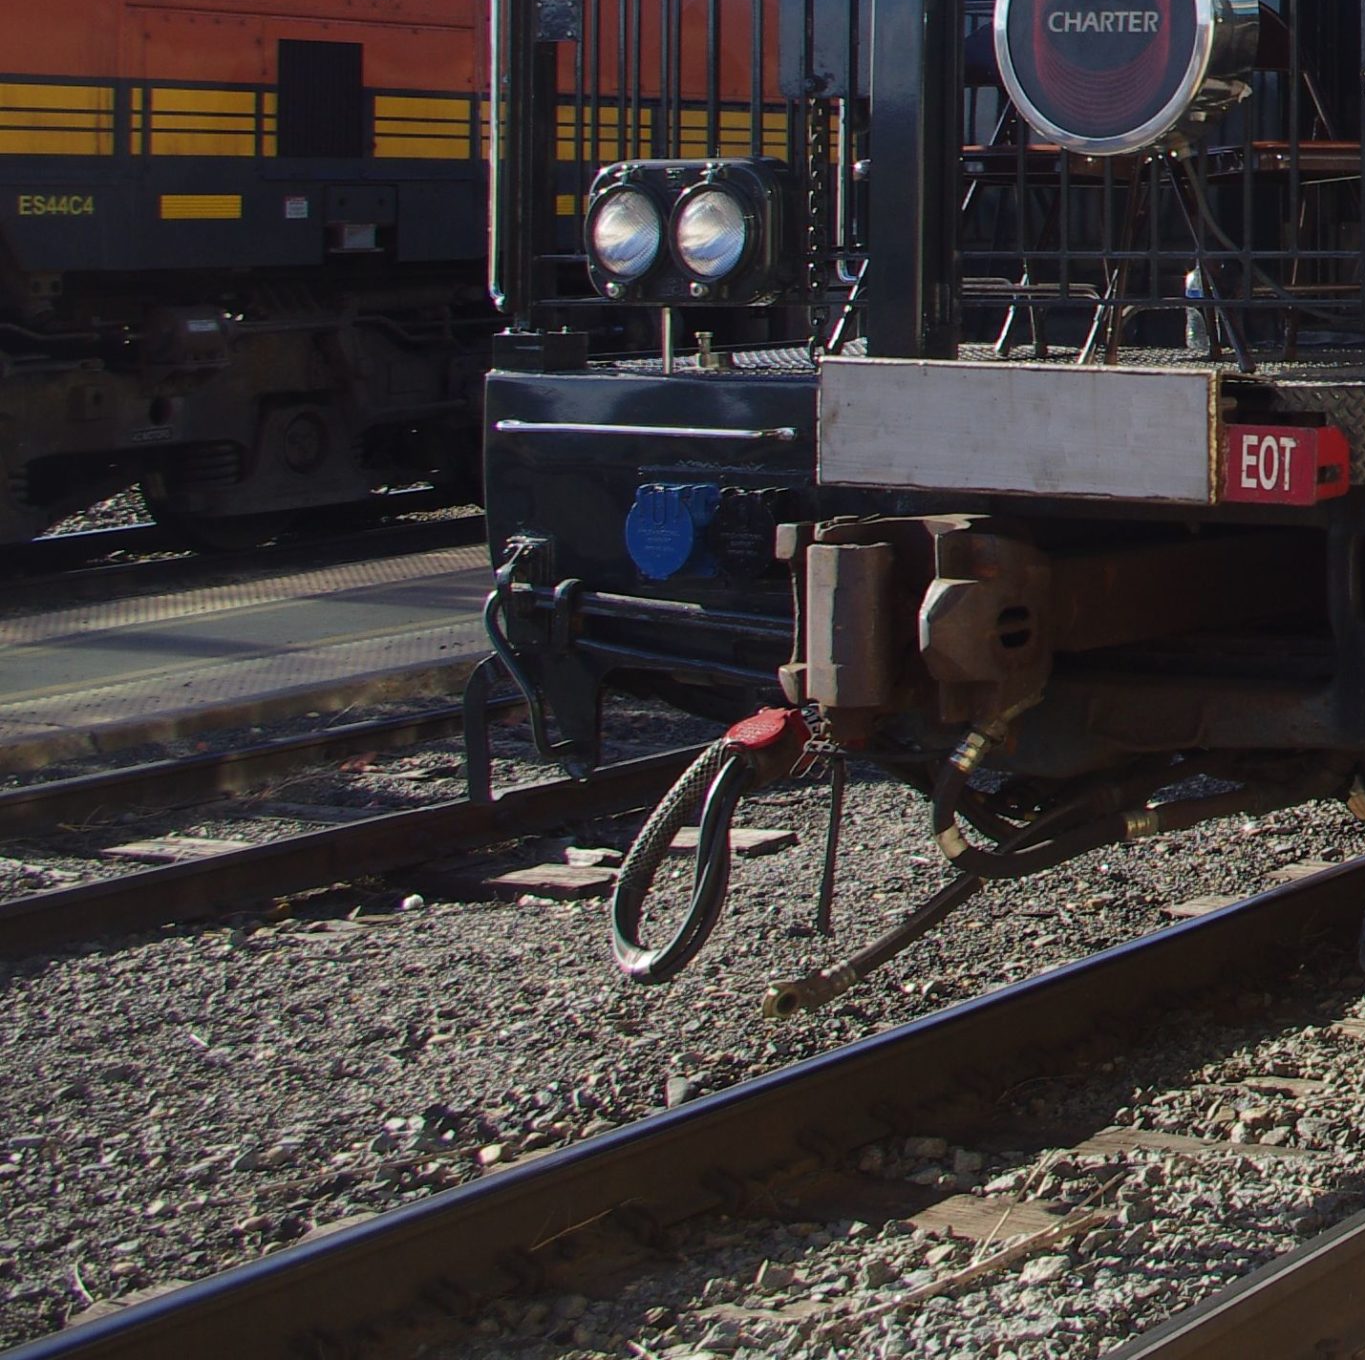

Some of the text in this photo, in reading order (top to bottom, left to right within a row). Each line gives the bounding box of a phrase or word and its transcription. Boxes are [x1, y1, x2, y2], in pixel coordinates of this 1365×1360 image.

[1047, 11, 1160, 33] CHARTER
[18, 194, 95, 216] ES44C4
[1240, 434, 1298, 492] EOT
